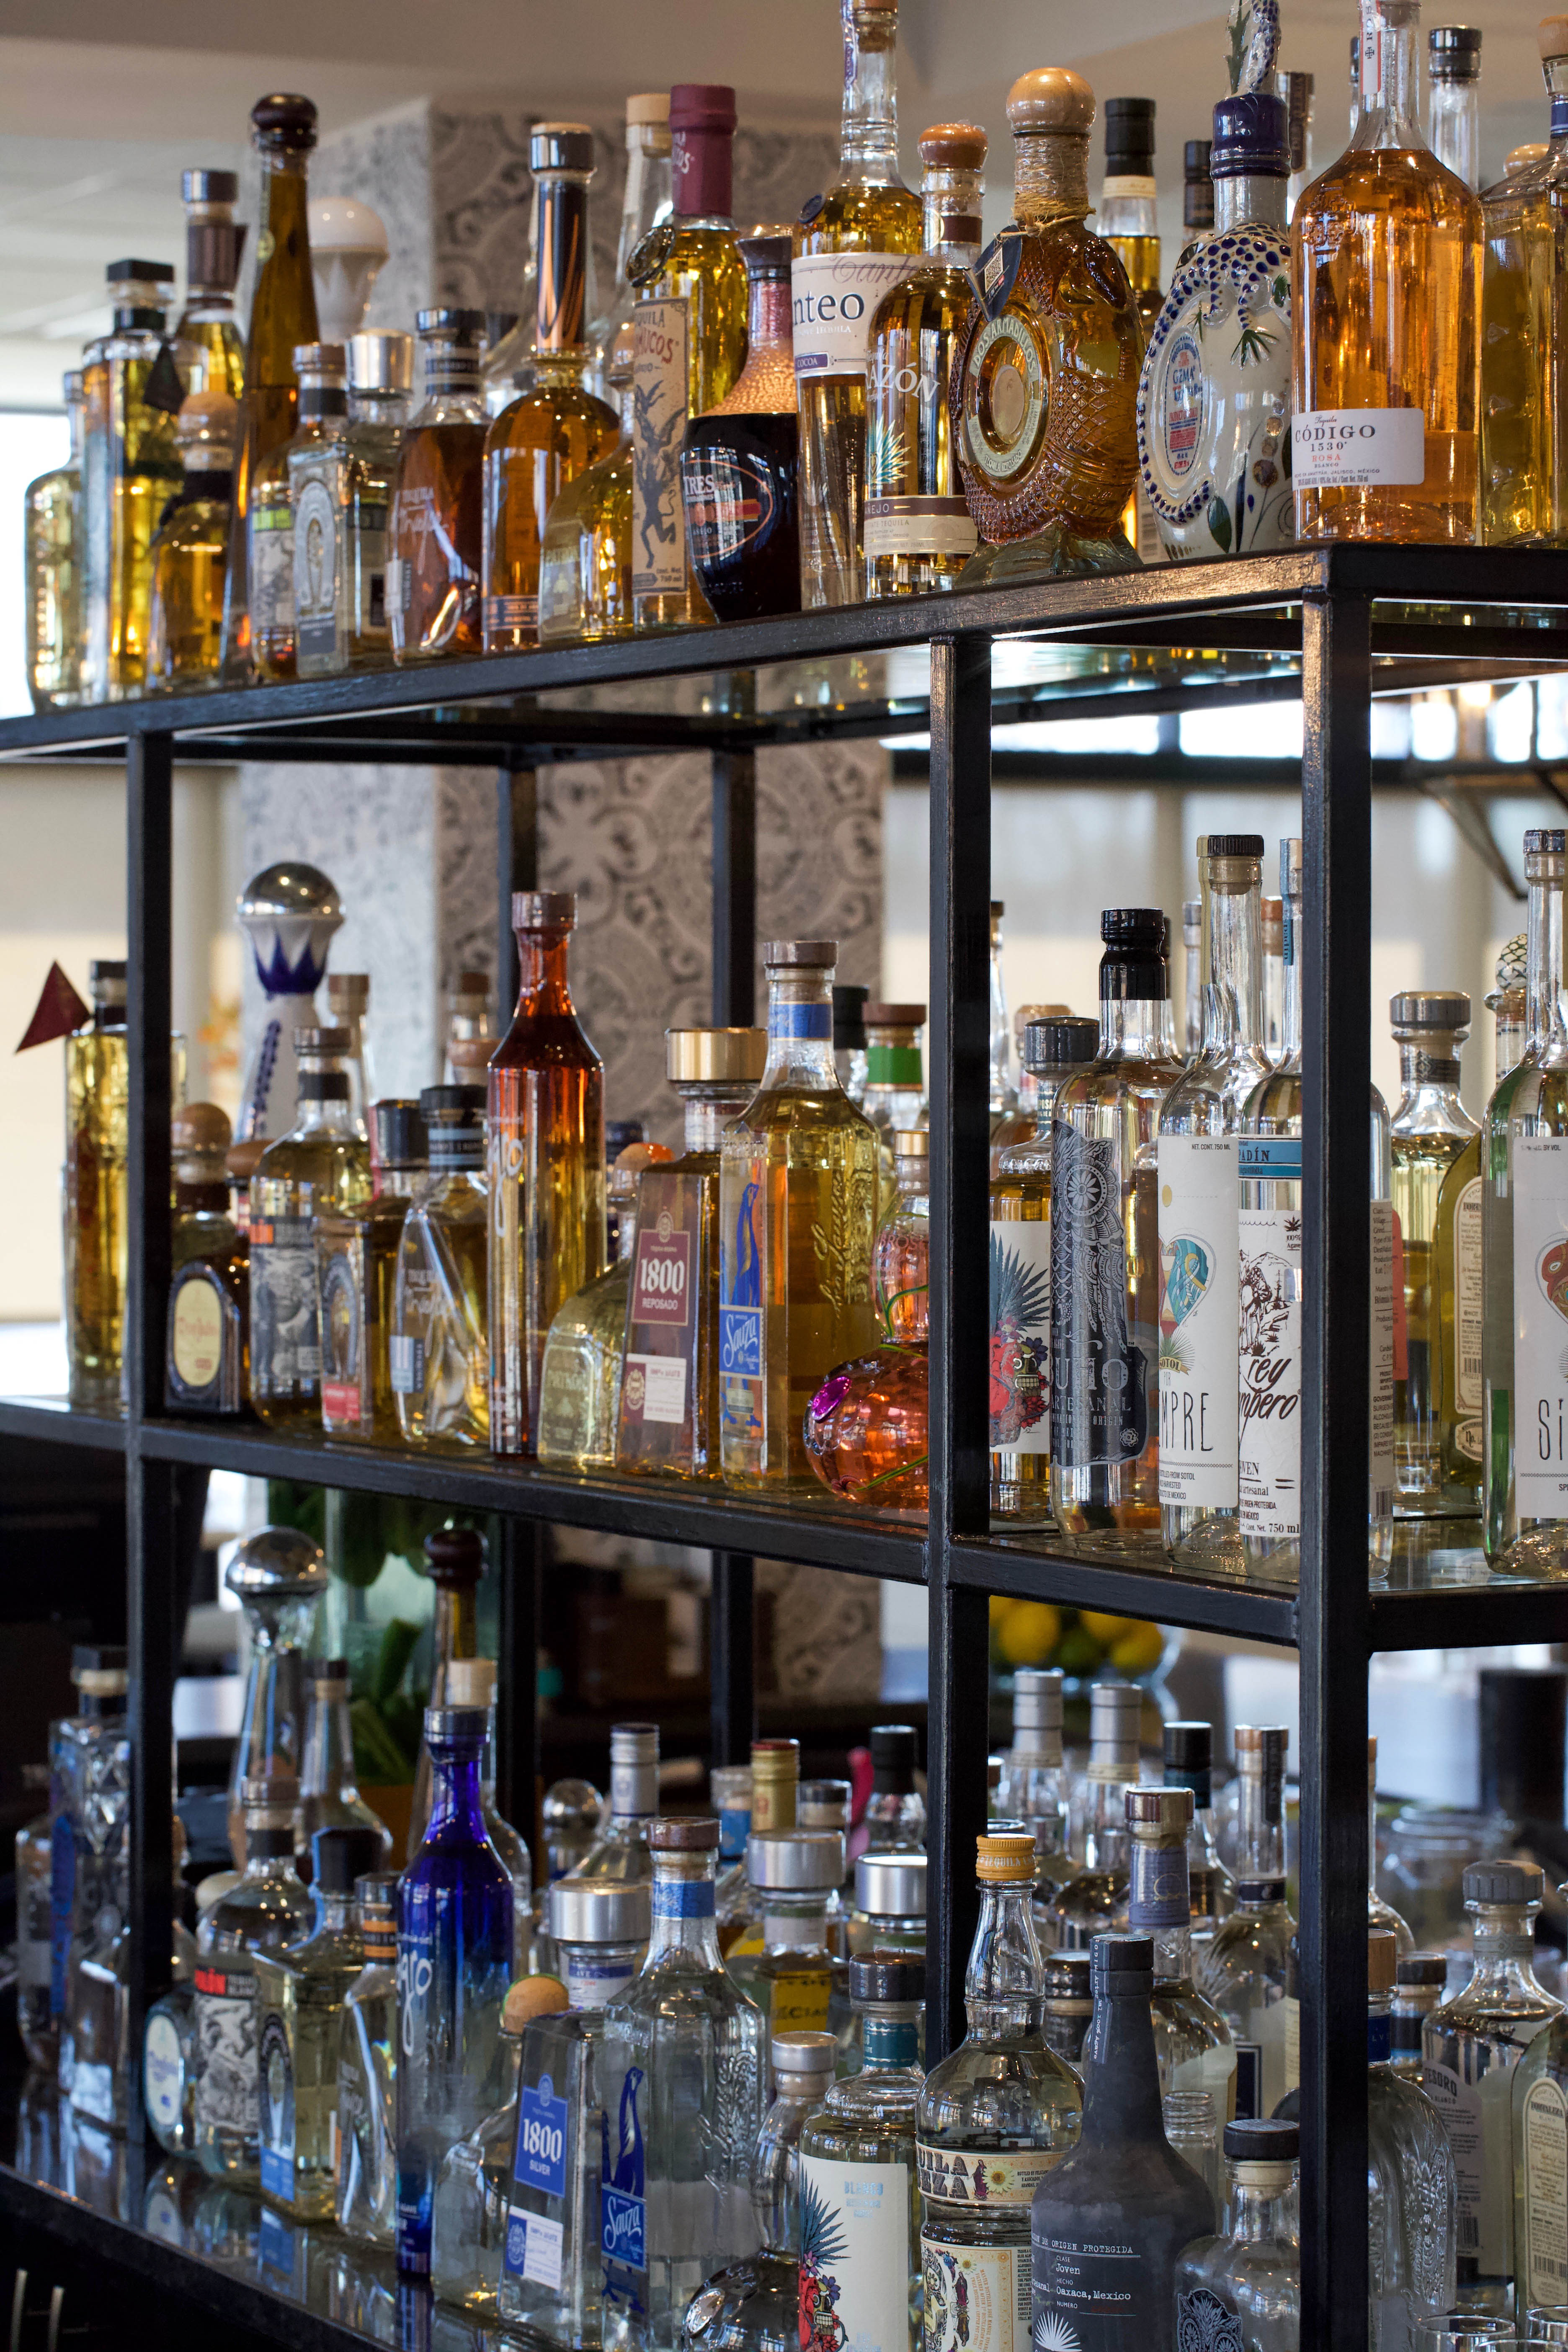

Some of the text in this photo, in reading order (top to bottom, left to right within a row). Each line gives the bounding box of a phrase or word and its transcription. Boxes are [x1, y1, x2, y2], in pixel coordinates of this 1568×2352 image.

[973, 317, 1036, 374] DOS ARMADILLOS
[797, 358, 818, 368] COCOA
[1314, 415, 1337, 427] Tequila
[1295, 424, 1375, 443] CÓDIGO
[1310, 441, 1344, 452] 1530
[1312, 454, 1341, 462] ROSA
[683, 475, 714, 496] TRES
[640, 1258, 685, 1295] 1800
[642, 1297, 678, 1310] REPOSADO
[723, 1313, 758, 1368] Sauza
[1243, 1358, 1292, 1394] rey
[1093, 1416, 1123, 1425] ORIGIN
[1159, 1389, 1214, 1451] MPRE
[1169, 1470, 1195, 1480] FROM SOTOL
[1243, 1485, 1269, 1496] artesanal
[1269, 1523, 1284, 1533] 750
[1287, 1523, 1300, 1533] ml
[985, 1856, 1021, 1868] TEQUILA
[523, 2118, 562, 2163] 1800
[844, 2181, 883, 2196] BLANCO
[603, 2195, 642, 2250] Sauza
[1052, 2240, 1077, 2251] ORIGEN
[1083, 2244, 1133, 2254] PROTEGIDA
[1056, 2263, 1081, 2275] Joven
[975, 2273, 984, 2292] FILTERED
[980, 2269, 988, 2285] MASTER
[1056, 2286, 1131, 2300] Oaxaca, Mexico
[1057, 2300, 1078, 2309] NUMERO
